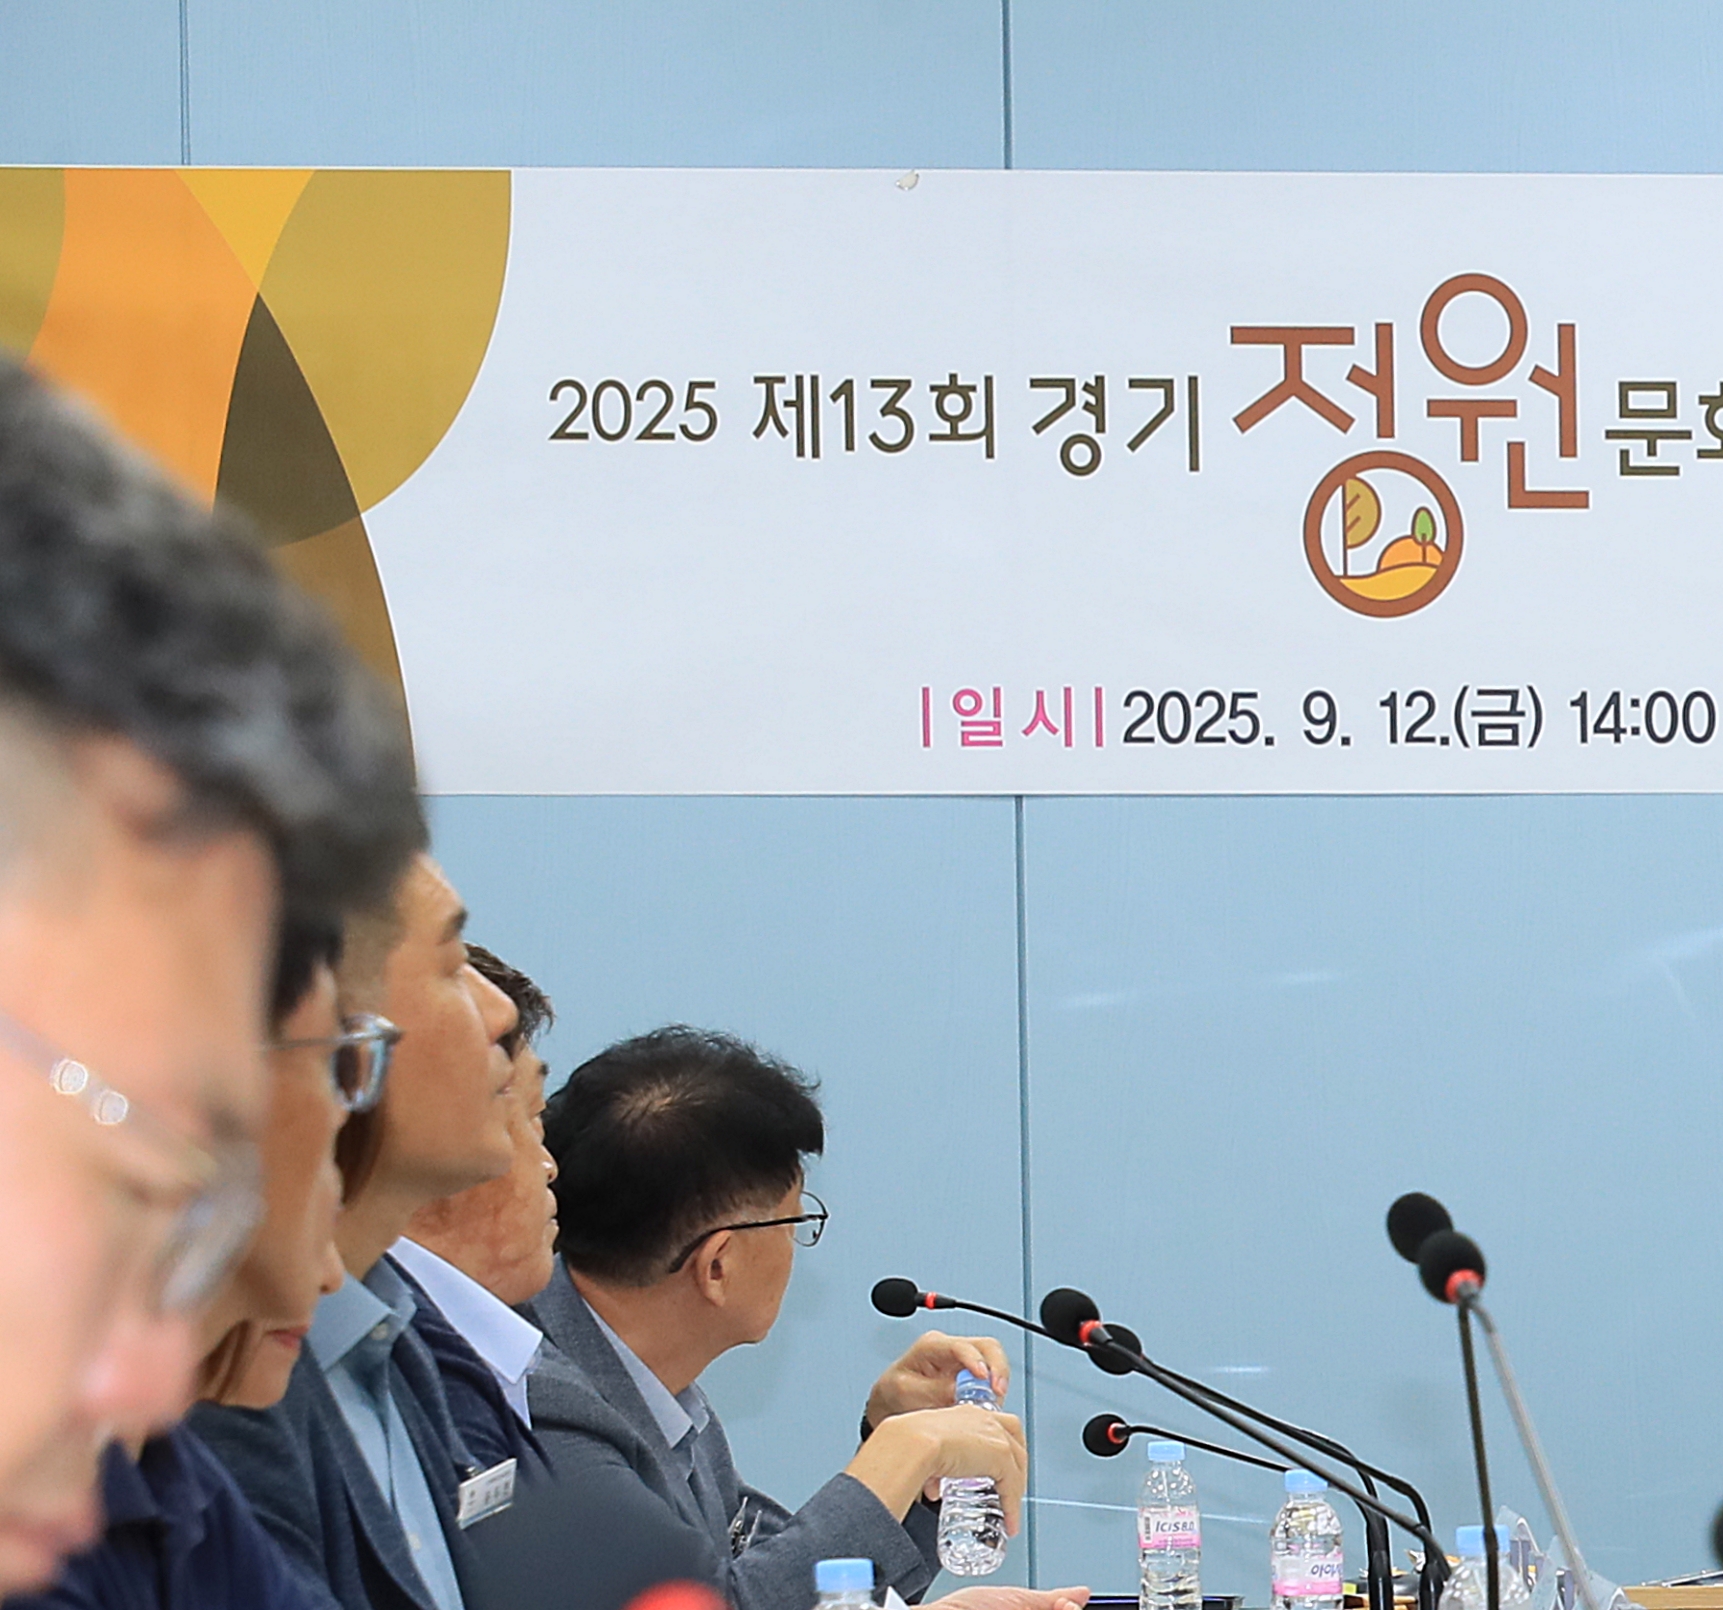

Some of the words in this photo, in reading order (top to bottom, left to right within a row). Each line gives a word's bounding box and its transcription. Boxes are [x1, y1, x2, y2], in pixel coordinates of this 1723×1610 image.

[547, 378, 718, 443] 2025
[752, 372, 996, 460] 제13회
[1028, 374, 1201, 478] 경기
[1229, 272, 1591, 620] 정원
[1122, 689, 1275, 747] 2025.
[1302, 689, 1352, 747] 9.
[1379, 684, 1543, 749] 12.(금)
[1569, 689, 1717, 745] 14:00
